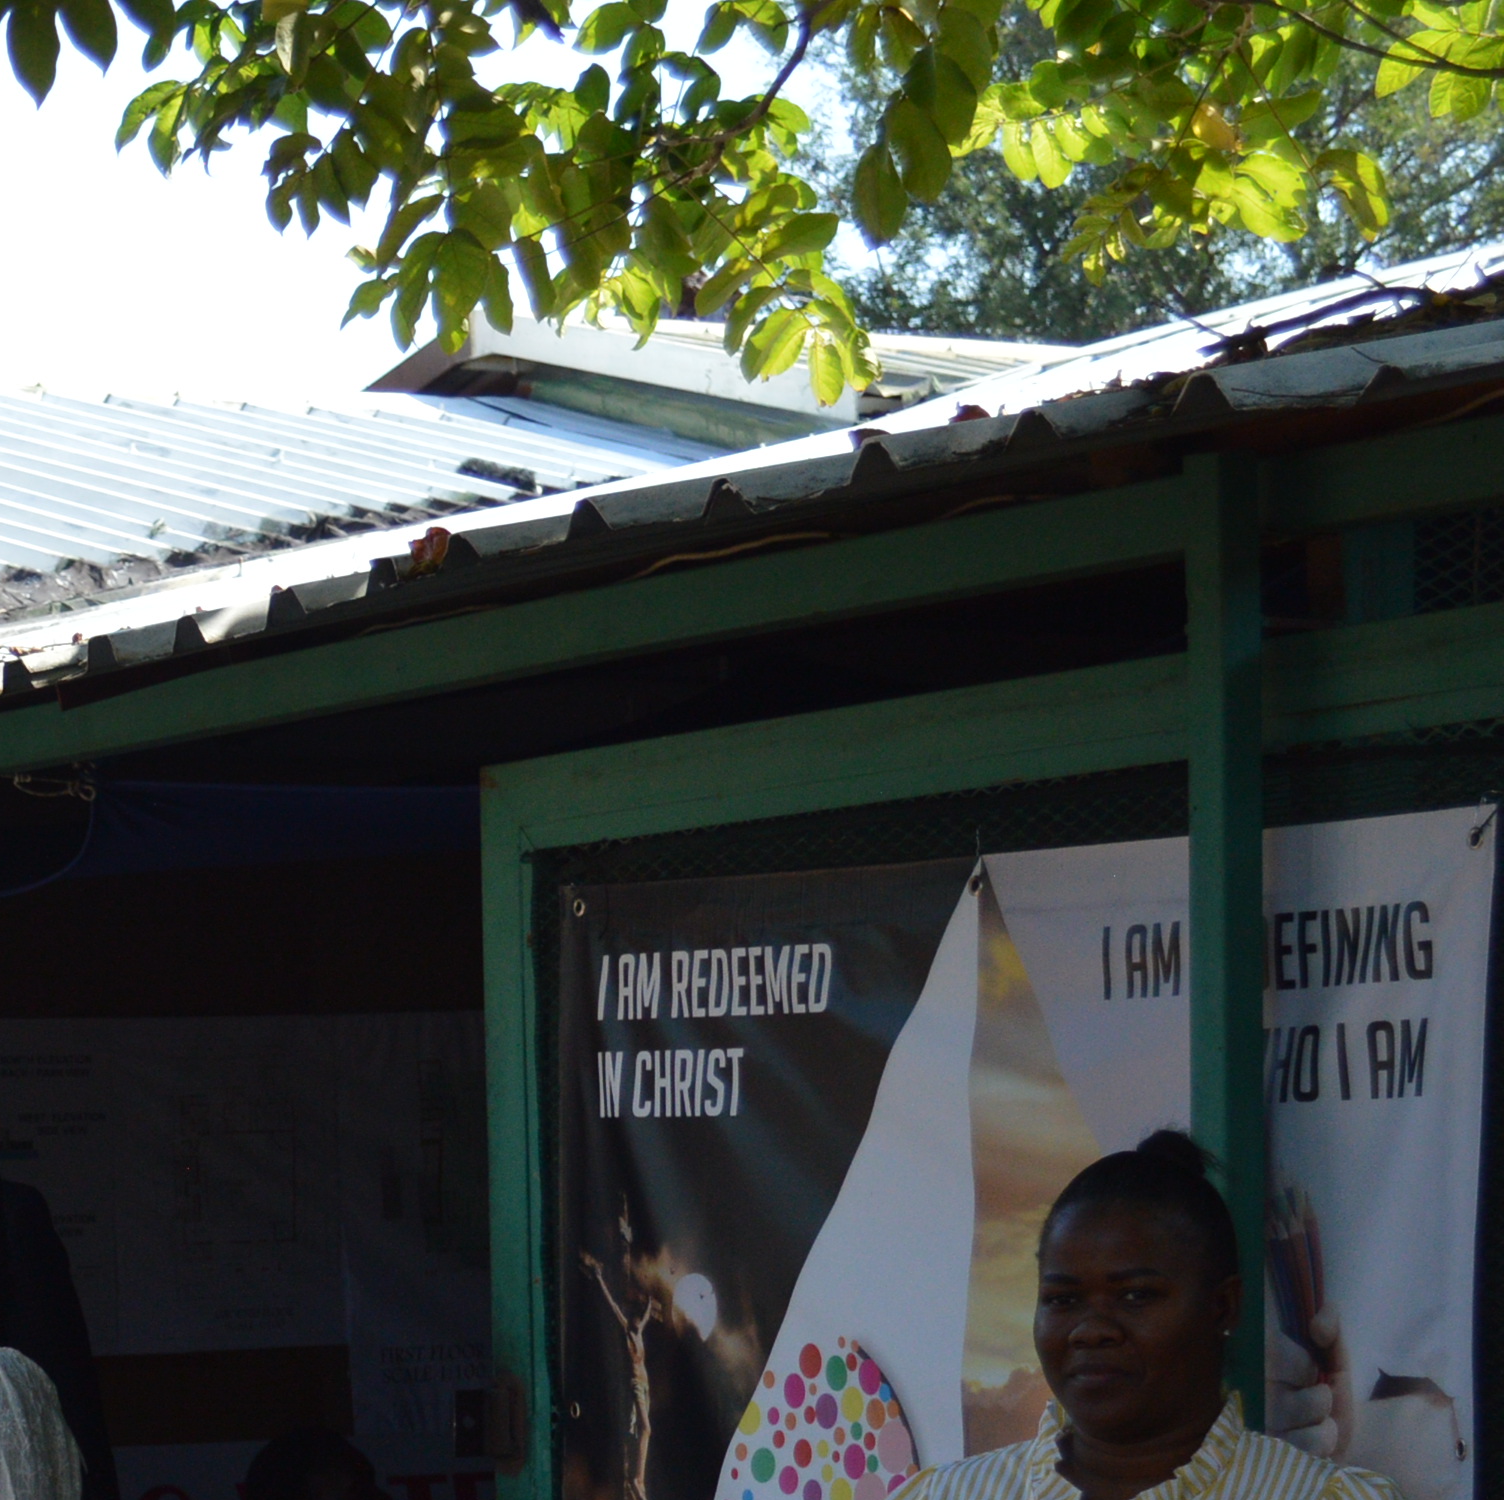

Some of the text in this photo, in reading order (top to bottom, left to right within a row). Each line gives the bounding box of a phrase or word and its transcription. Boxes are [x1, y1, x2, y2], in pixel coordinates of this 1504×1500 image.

[597, 943, 833, 1021] I AM REDEEMED
[1101, 900, 1434, 1001] I AM EFINING
[597, 1047, 745, 1119] IN CHRIST
[1336, 1021, 1352, 1101] I
[1366, 1017, 1429, 1099] AM
[380, 1343, 486, 1364] FIRST FLOOR
[381, 1364, 433, 1385] SCALE
